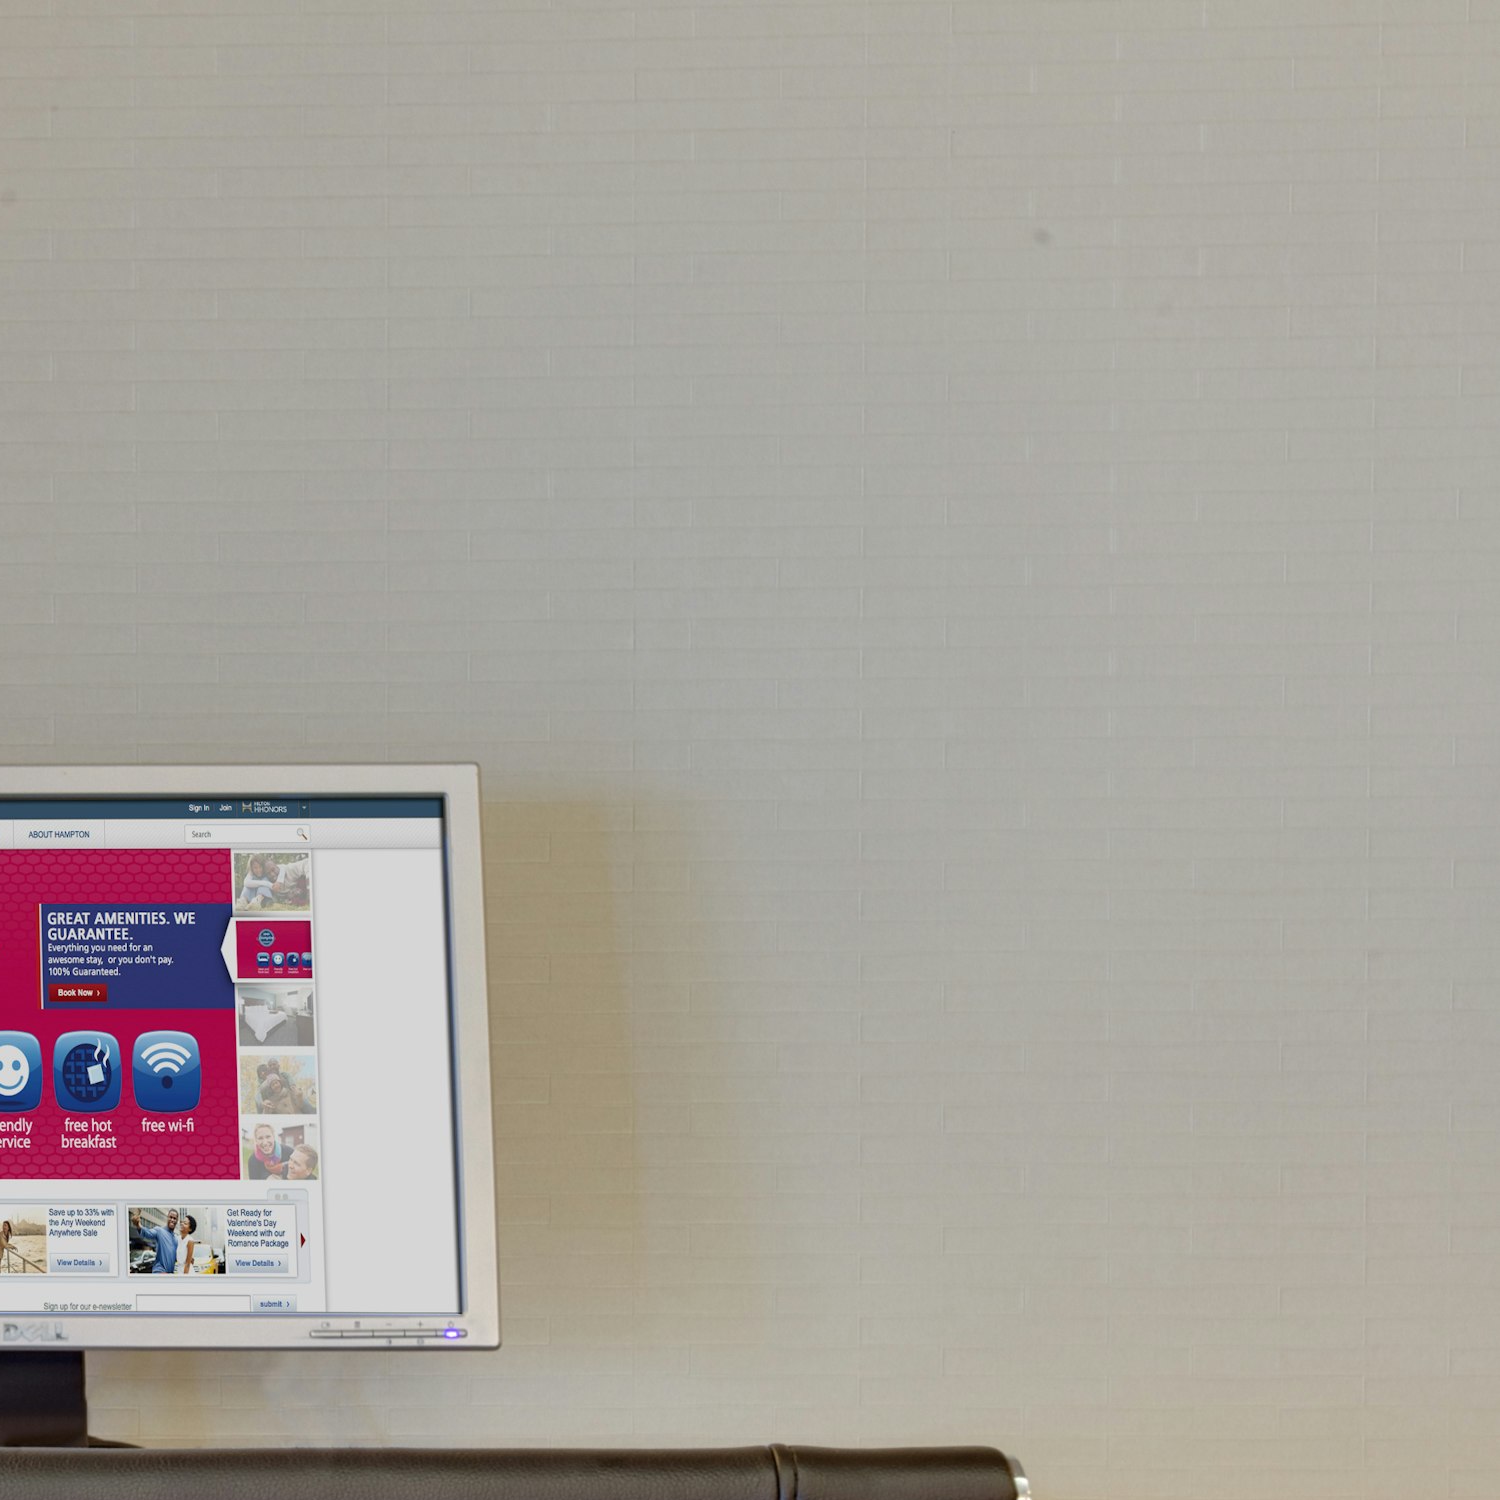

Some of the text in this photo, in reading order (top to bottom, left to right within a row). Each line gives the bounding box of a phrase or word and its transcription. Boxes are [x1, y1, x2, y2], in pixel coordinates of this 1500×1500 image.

[188, 804, 203, 813] Sign
[28, 830, 90, 838] ABOUT HAMPTON
[191, 830, 212, 838] Search
[47, 912, 196, 925] GREAT AMENITIES. WE
[48, 928, 134, 940] GUARANTEE.
[48, 943, 89, 953] Everything
[91, 945, 106, 953] you
[108, 943, 128, 952] need
[129, 943, 142, 952] for
[86, 956, 104, 965] stay,
[118, 957, 133, 966] you
[135, 955, 156, 964] don't
[158, 957, 174, 966] pay.
[48, 968, 121, 976] 100% Guaranteed.
[58, 988, 94, 997] Book Now
[64, 1117, 113, 1132] free hot
[141, 1117, 194, 1132] free wi-fi
[61, 1134, 117, 1148] breakfast
[48, 1208, 66, 1216] Save
[76, 1208, 84, 1216] to
[85, 1208, 100, 1216] 33%
[101, 1208, 114, 1216] with
[241, 1209, 262, 1218] Ready
[60, 1219, 74, 1228] Any
[263, 1219, 277, 1228] Day
[48, 1229, 82, 1237] Anywhere
[227, 1229, 258, 1237] Weekend
[259, 1229, 273, 1237] with
[261, 1240, 289, 1249] Package
[43, 1302, 58, 1311] Sign
[69, 1302, 79, 1310] for
[92, 1302, 132, 1310] e-newsletter
[260, 1300, 283, 1308] submit
[3, 1322, 68, 1342] DELL
